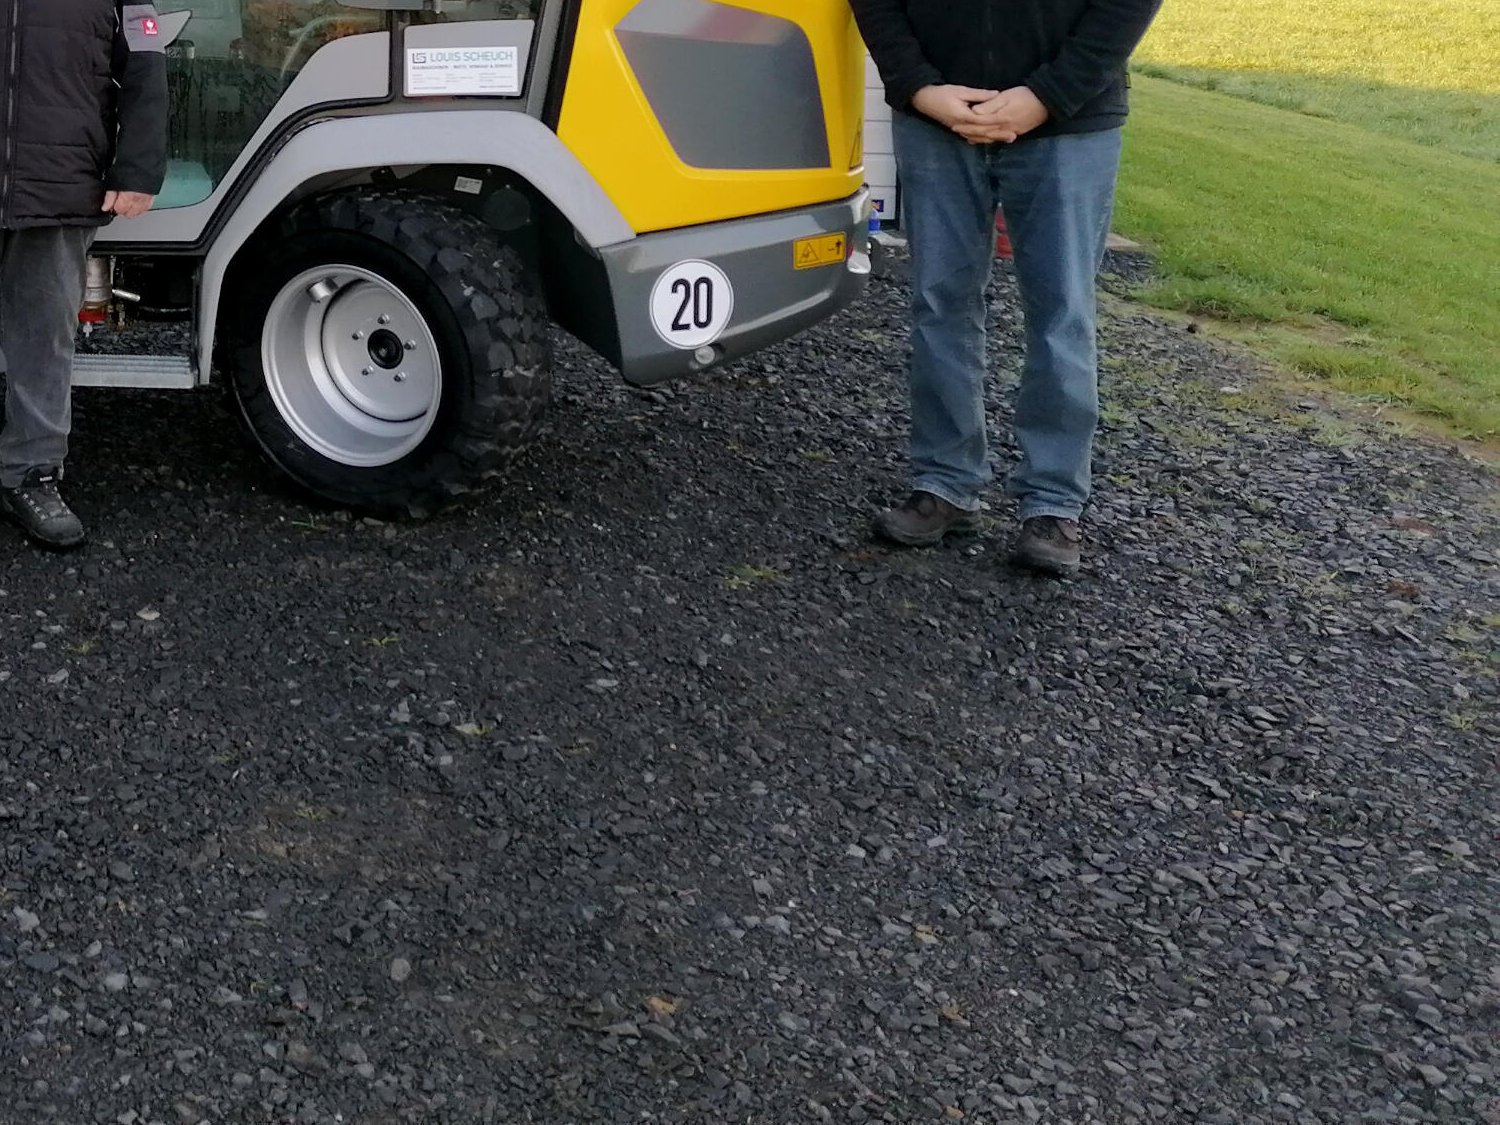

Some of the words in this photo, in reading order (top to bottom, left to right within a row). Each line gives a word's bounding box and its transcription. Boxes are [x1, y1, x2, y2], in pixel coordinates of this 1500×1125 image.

[430, 52, 460, 62] LOUIS
[462, 50, 513, 61] SCHEUCH
[671, 276, 713, 331] 20
